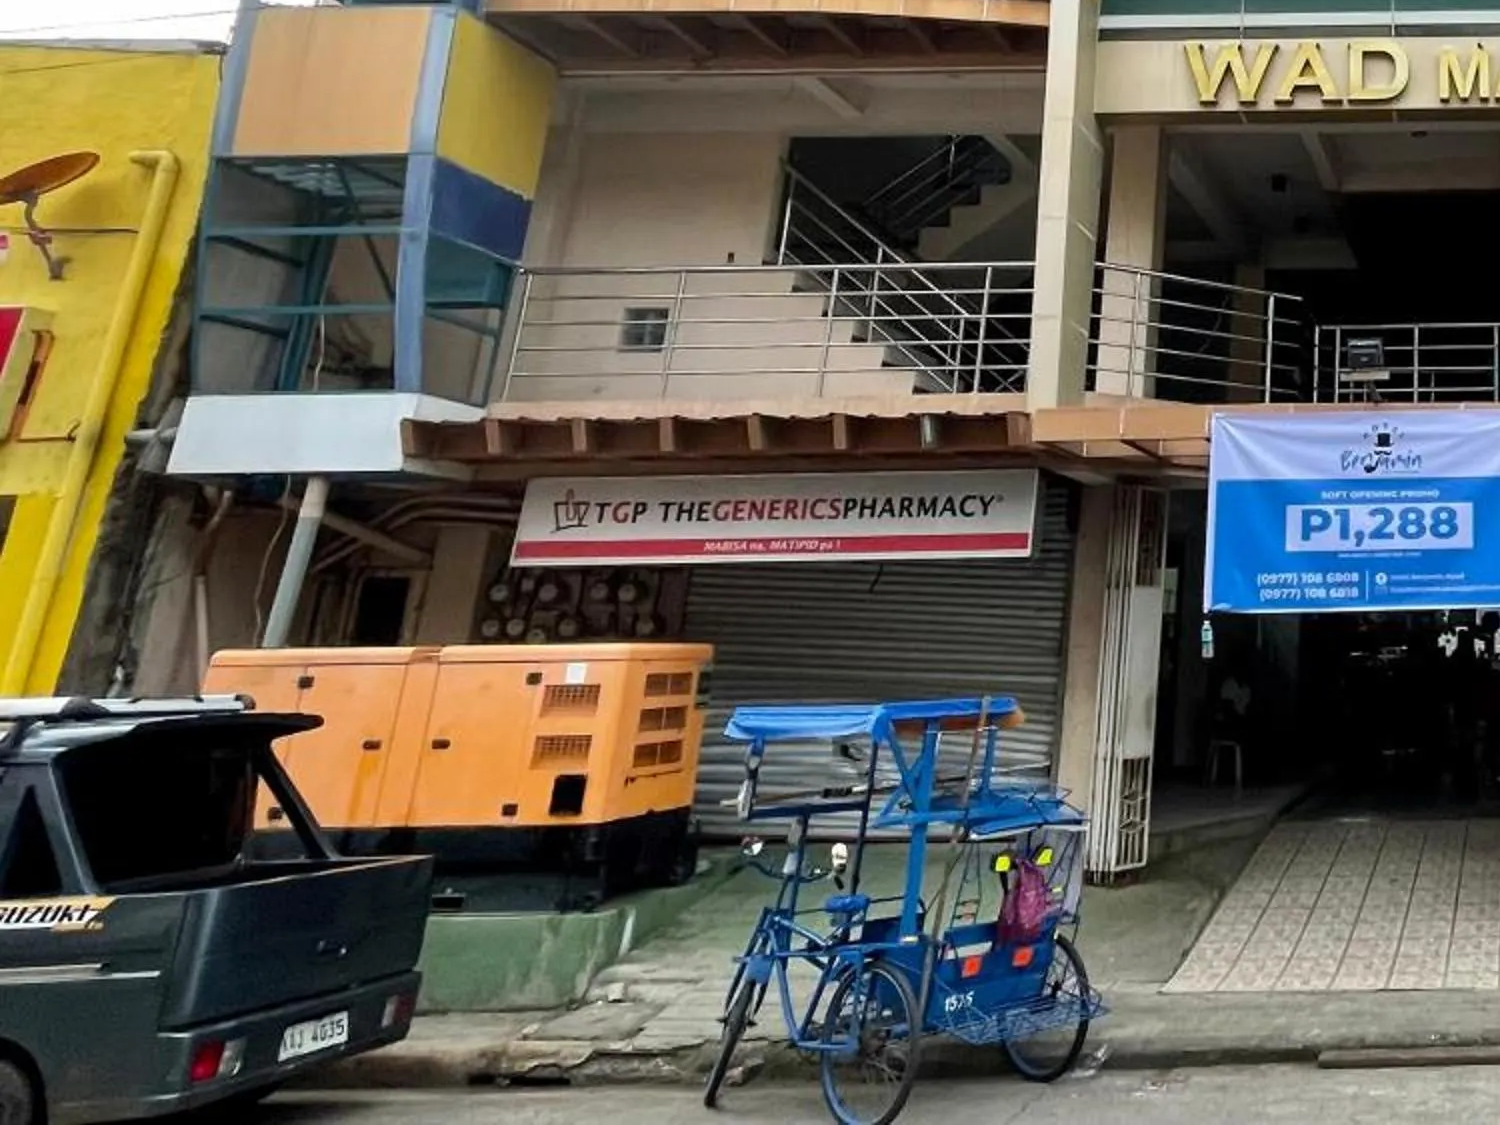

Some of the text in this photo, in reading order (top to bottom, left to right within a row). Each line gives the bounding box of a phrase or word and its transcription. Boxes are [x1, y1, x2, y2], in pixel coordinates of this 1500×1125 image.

[1184, 40, 1410, 106] WAD
[595, 494, 996, 524] TGP THEGENERICSPHARMACY
[1301, 507, 1458, 547] P1,288
